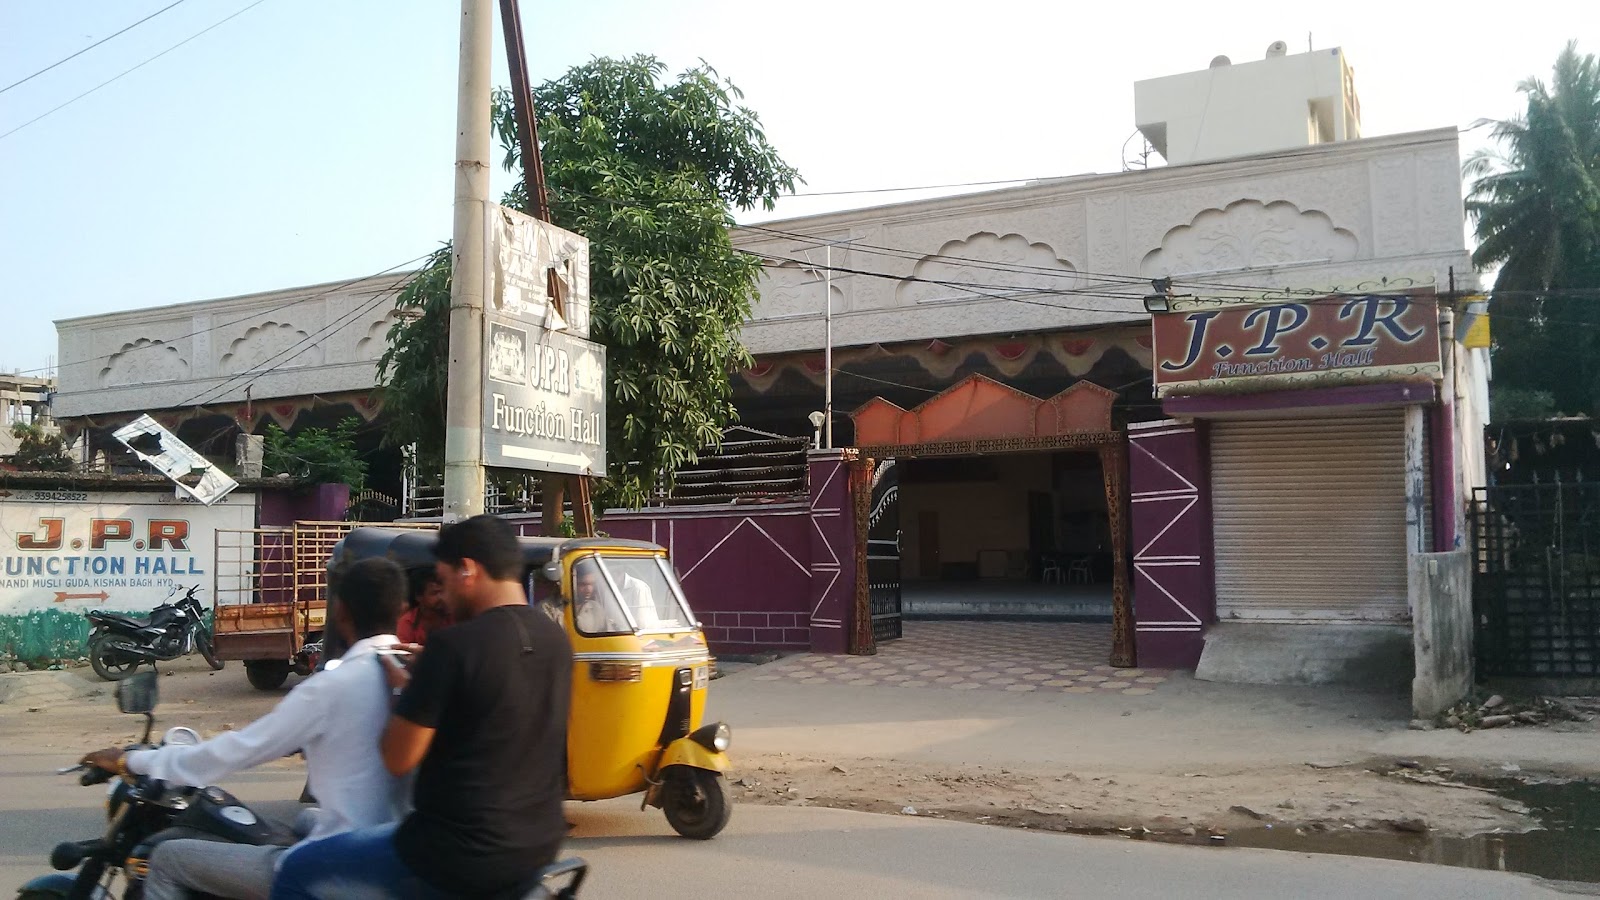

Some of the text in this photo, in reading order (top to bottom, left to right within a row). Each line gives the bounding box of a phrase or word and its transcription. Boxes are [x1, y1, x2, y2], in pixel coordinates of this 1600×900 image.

[1210, 346, 1378, 380] Function Hall
[491, 392, 600, 445] Function Hall
[16, 517, 190, 551] J.P.R
[94, 578, 126, 588] KISHAN
[135, 556, 205, 576] HALL
